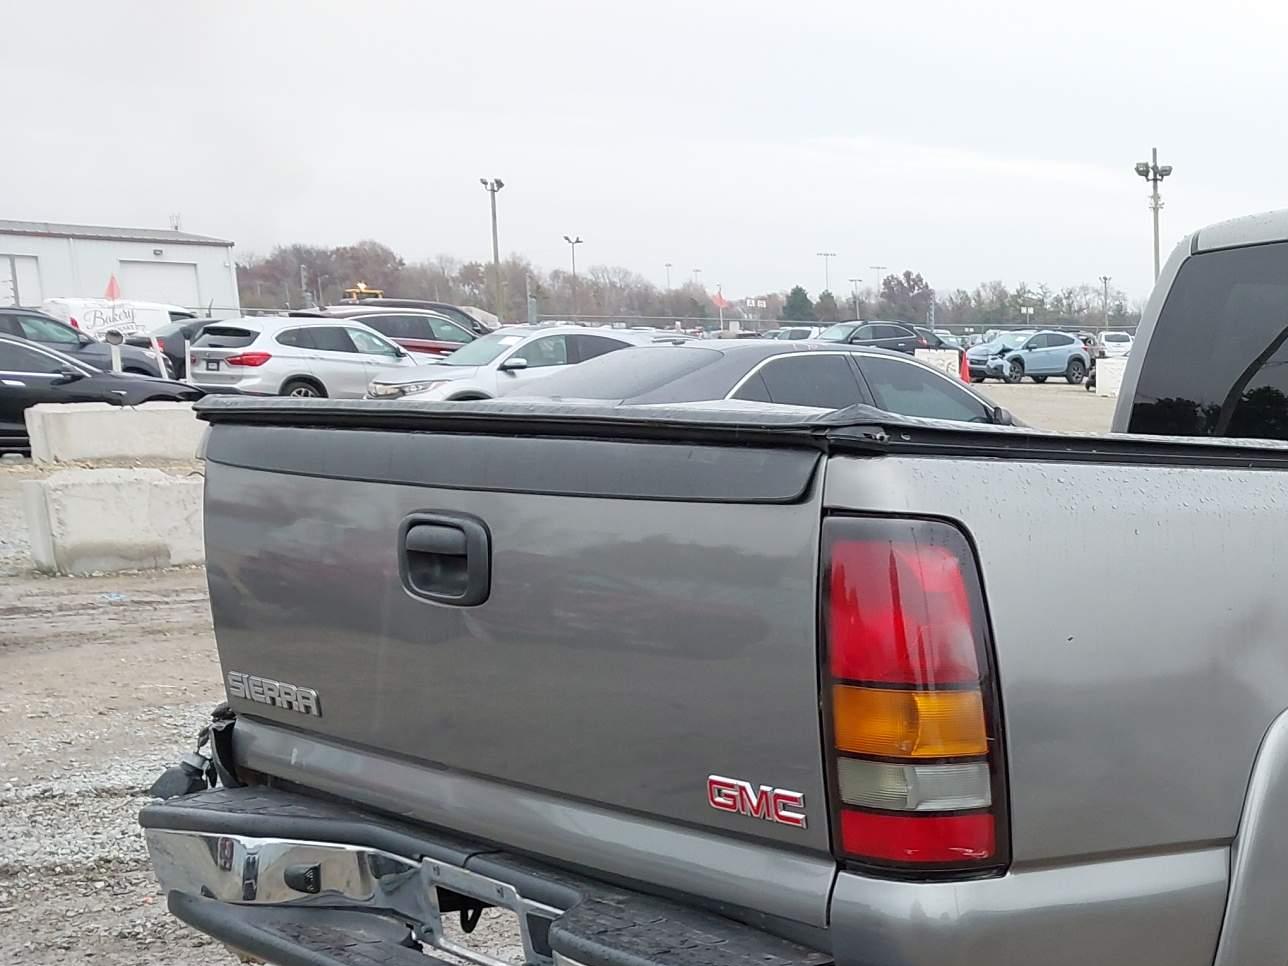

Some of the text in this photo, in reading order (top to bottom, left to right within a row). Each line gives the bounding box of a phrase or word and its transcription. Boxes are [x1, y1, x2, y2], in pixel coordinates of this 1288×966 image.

[84, 305, 135, 330] Bakery
[227, 671, 322, 717] SIERRA
[707, 775, 807, 829] GMC
